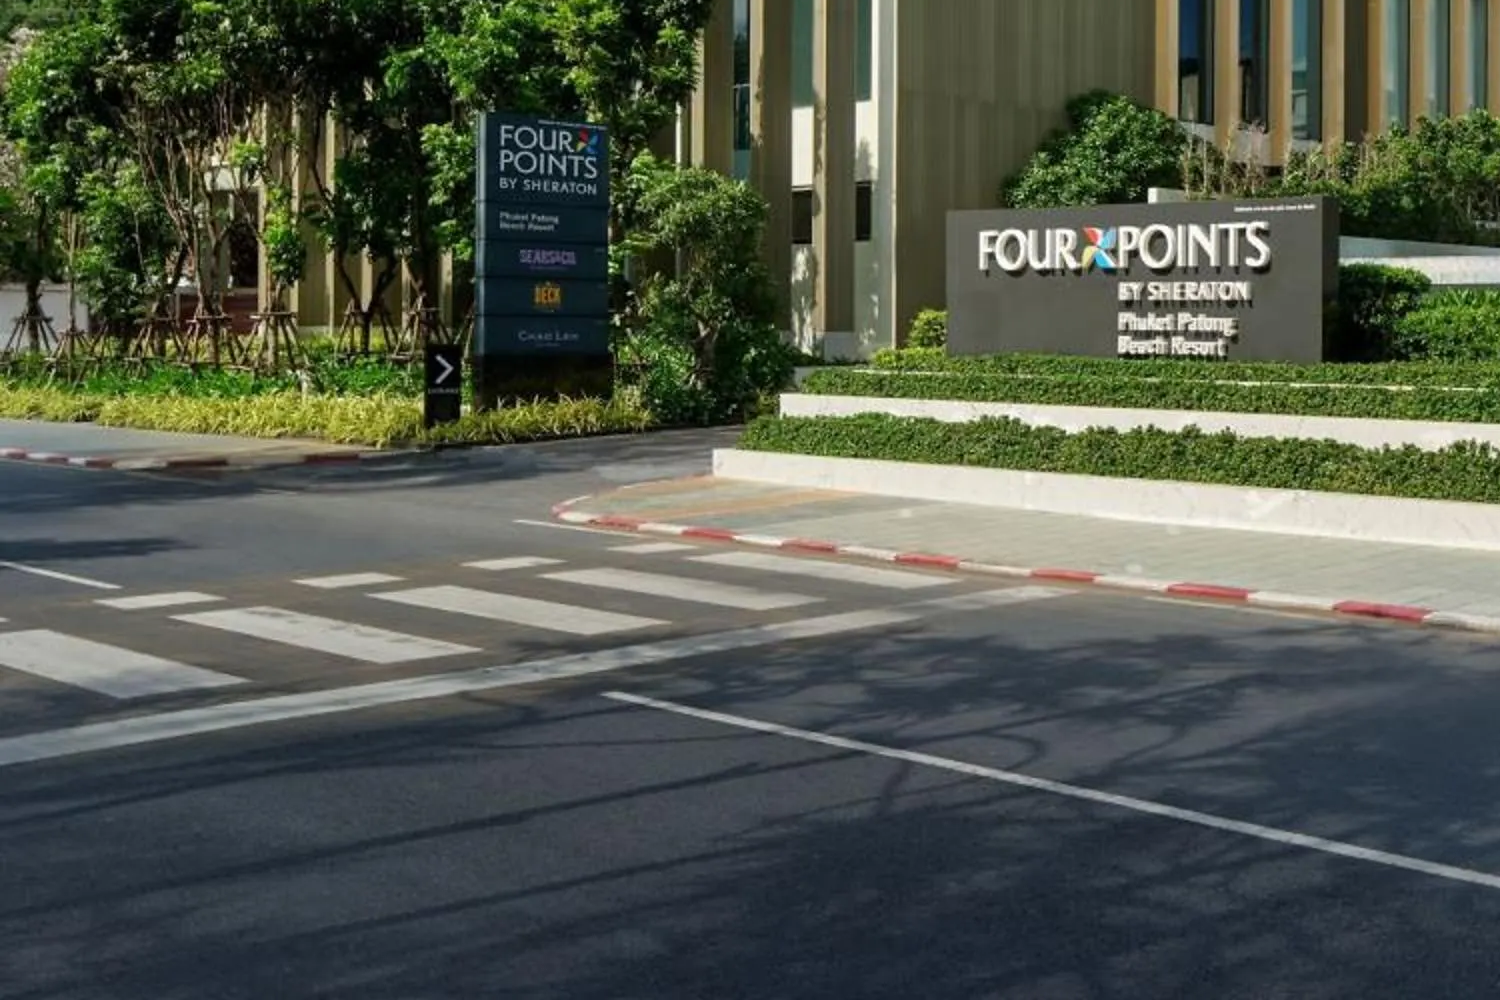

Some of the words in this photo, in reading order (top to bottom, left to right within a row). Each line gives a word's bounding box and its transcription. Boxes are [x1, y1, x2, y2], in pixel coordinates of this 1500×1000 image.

[499, 124, 575, 153] FOUR
[499, 149, 598, 179] POINTS
[499, 177, 517, 190] BY
[523, 178, 597, 196] SHERATON
[978, 228, 1082, 271] FOUR
[1118, 220, 1271, 269] POINTS
[1118, 281, 1144, 301] BY
[1147, 281, 1252, 301] SHERATON
[1118, 312, 1174, 331] Phuket
[1177, 312, 1239, 337] Patong
[1118, 335, 1169, 355] Beach
[1171, 336, 1227, 357] Resort
